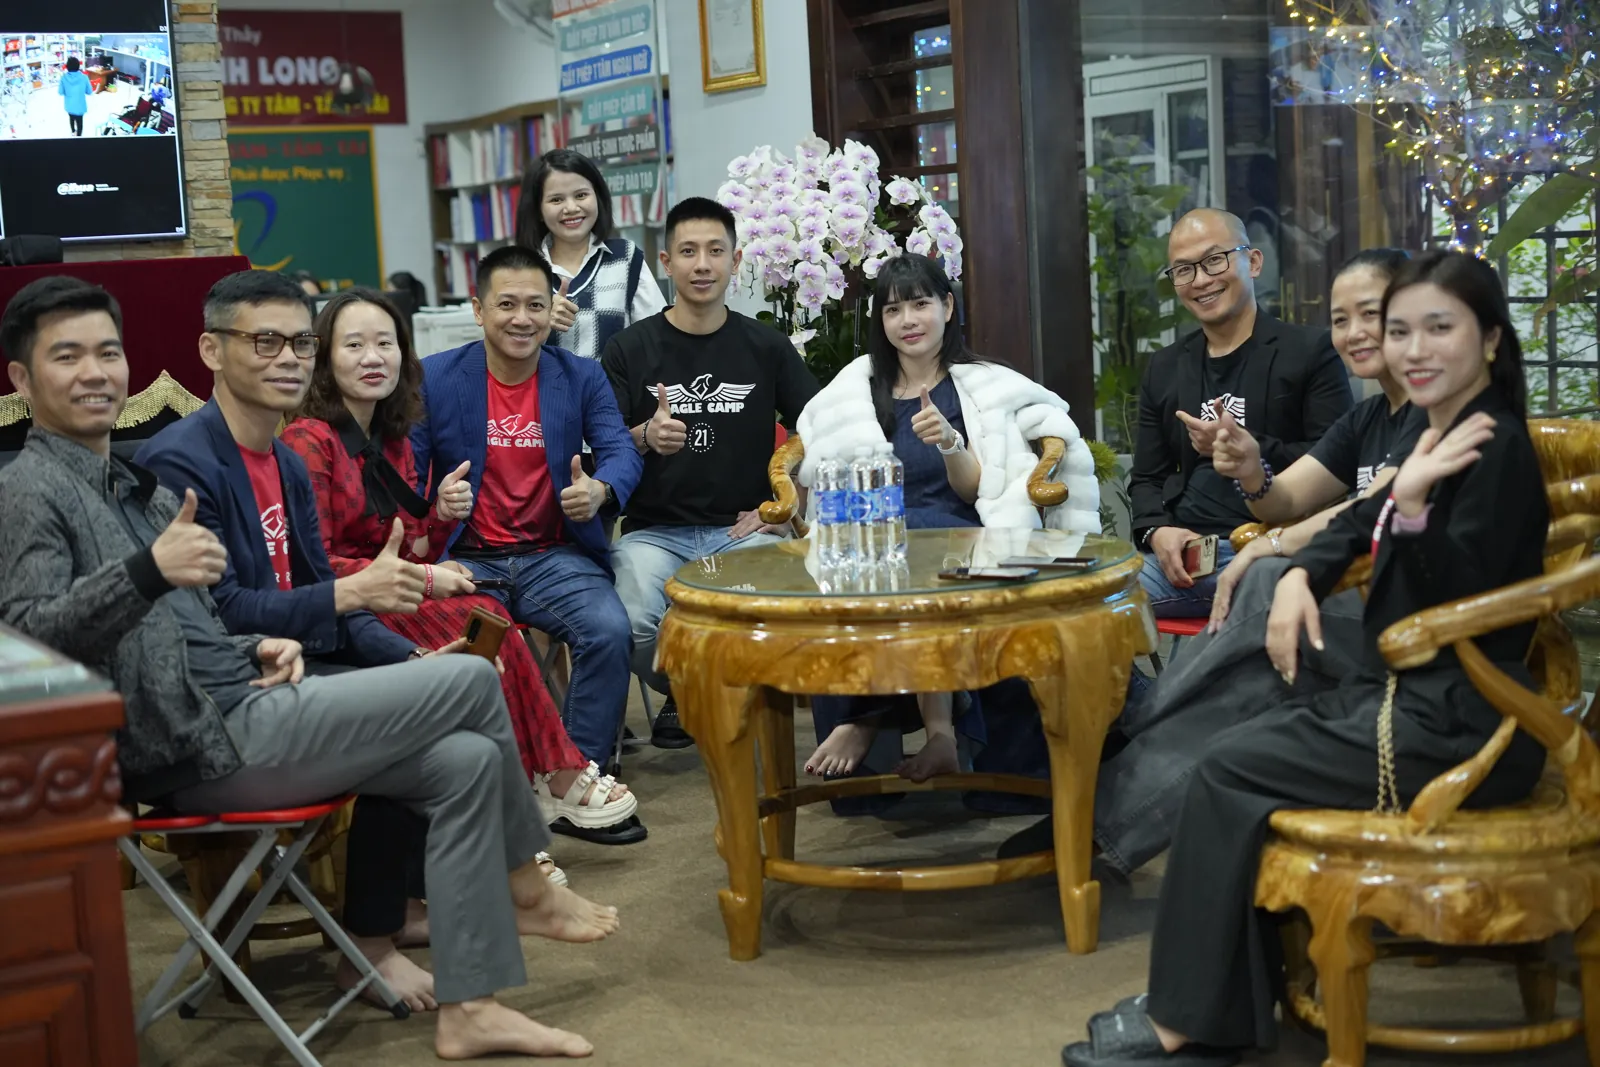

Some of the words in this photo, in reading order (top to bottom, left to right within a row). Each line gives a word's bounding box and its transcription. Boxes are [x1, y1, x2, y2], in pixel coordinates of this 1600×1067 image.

[670, 402, 702, 414] AGLE
[707, 402, 745, 413] CAMP
[694, 429, 708, 447] 21
